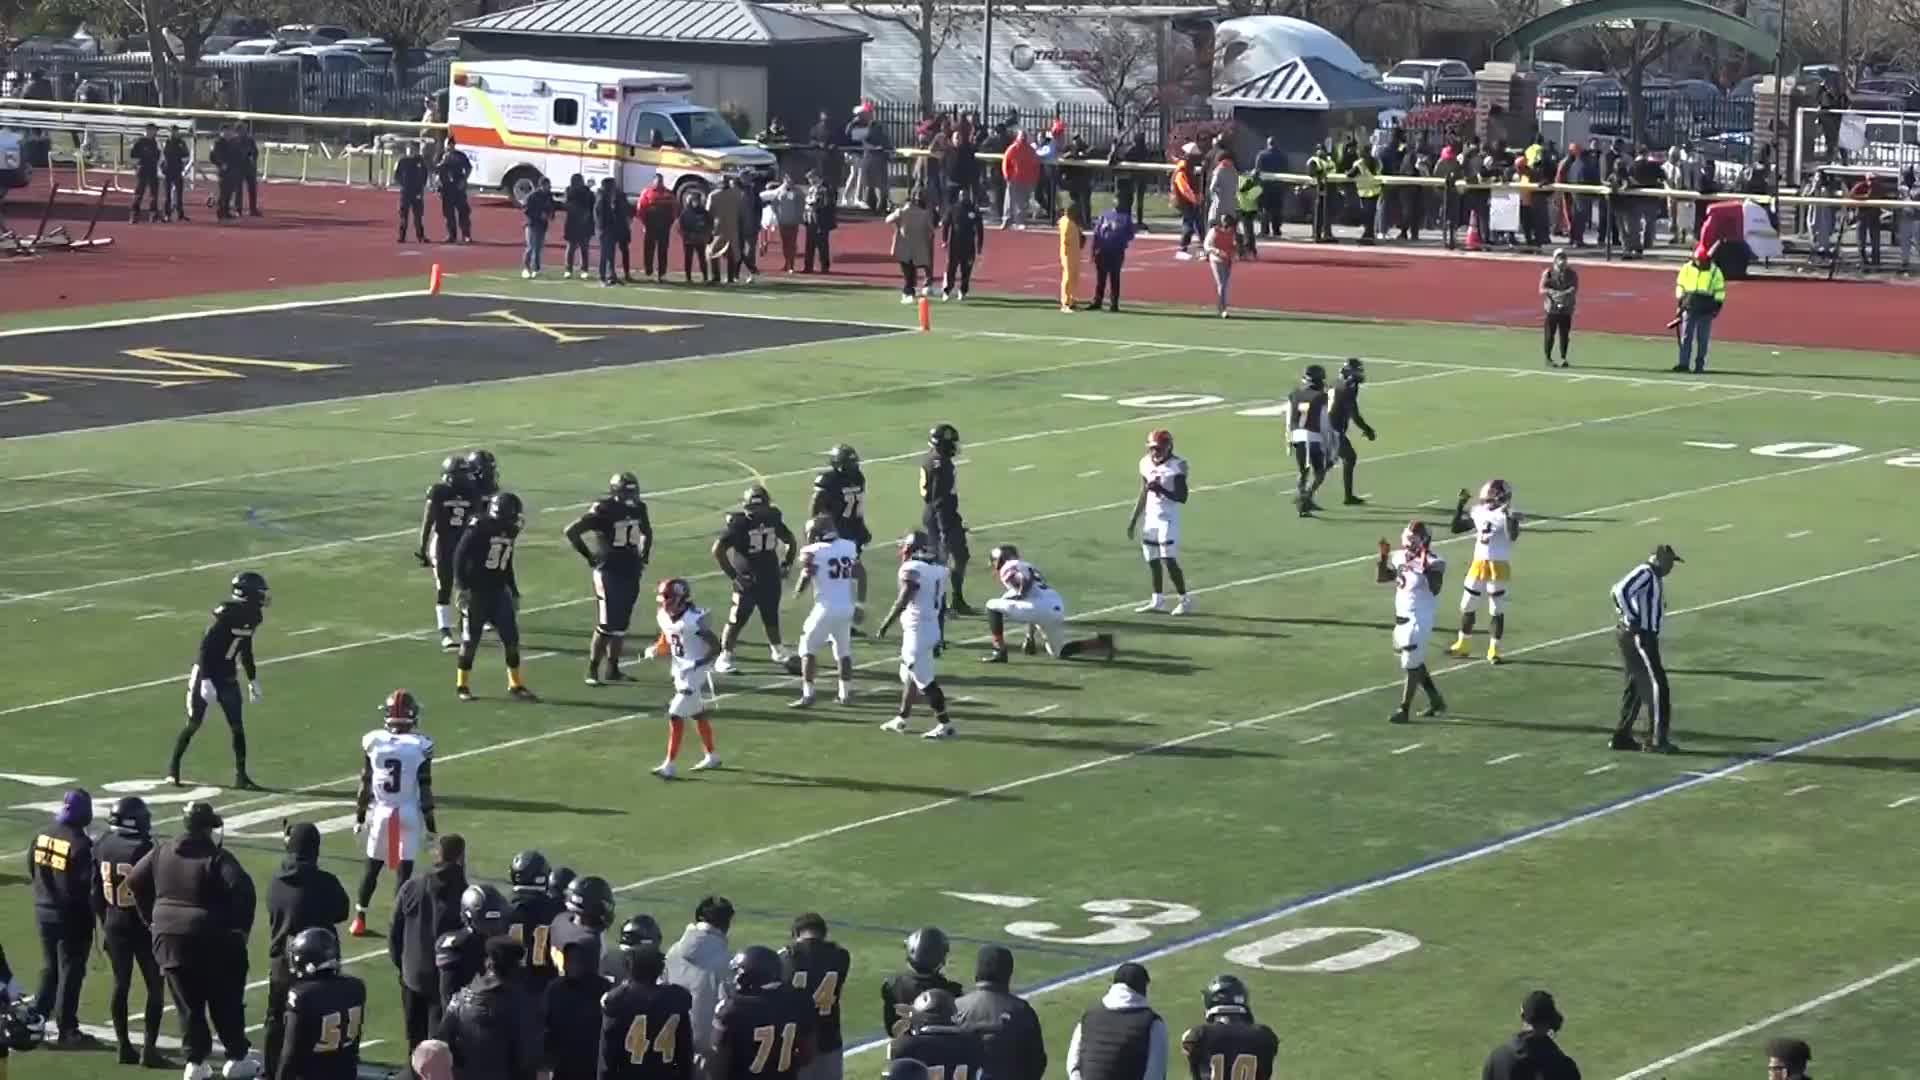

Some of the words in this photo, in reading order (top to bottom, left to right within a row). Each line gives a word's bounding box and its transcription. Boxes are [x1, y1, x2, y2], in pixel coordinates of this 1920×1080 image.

[383, 758, 402, 793] 3
[624, 1014, 681, 1065] 44
[749, 1023, 797, 1073] 71
